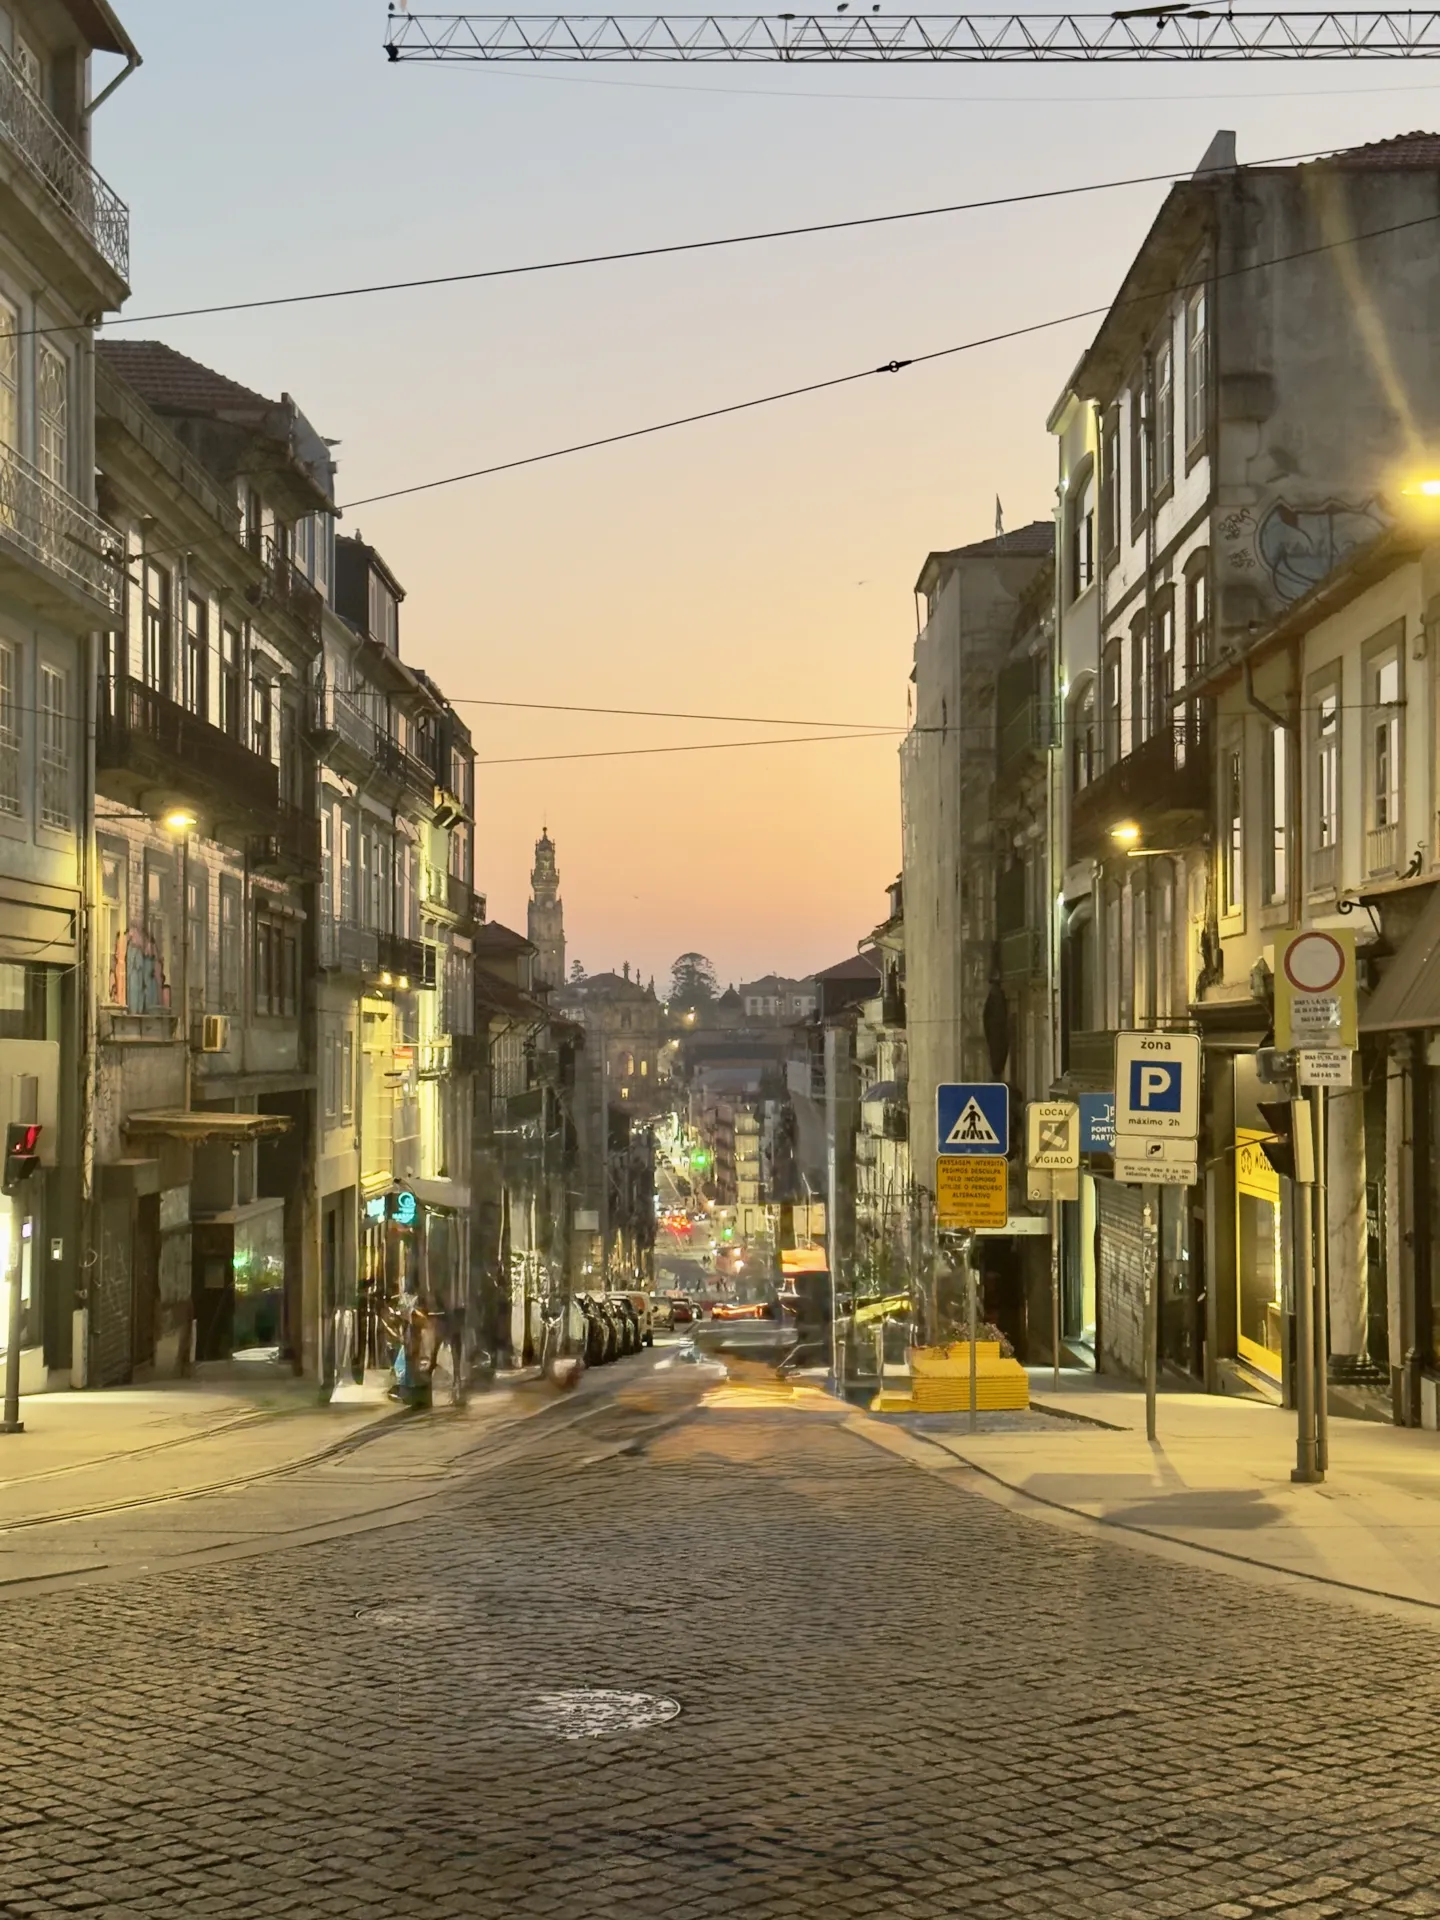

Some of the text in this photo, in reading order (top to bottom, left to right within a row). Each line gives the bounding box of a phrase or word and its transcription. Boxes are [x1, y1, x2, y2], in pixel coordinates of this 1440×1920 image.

[1140, 1040, 1171, 1050] zona
[1140, 1067, 1171, 1106] P
[1040, 1108, 1069, 1116] LOCAL
[1128, 1118, 1163, 1127] máximo
[1035, 1156, 1072, 1164] VIGIADO
